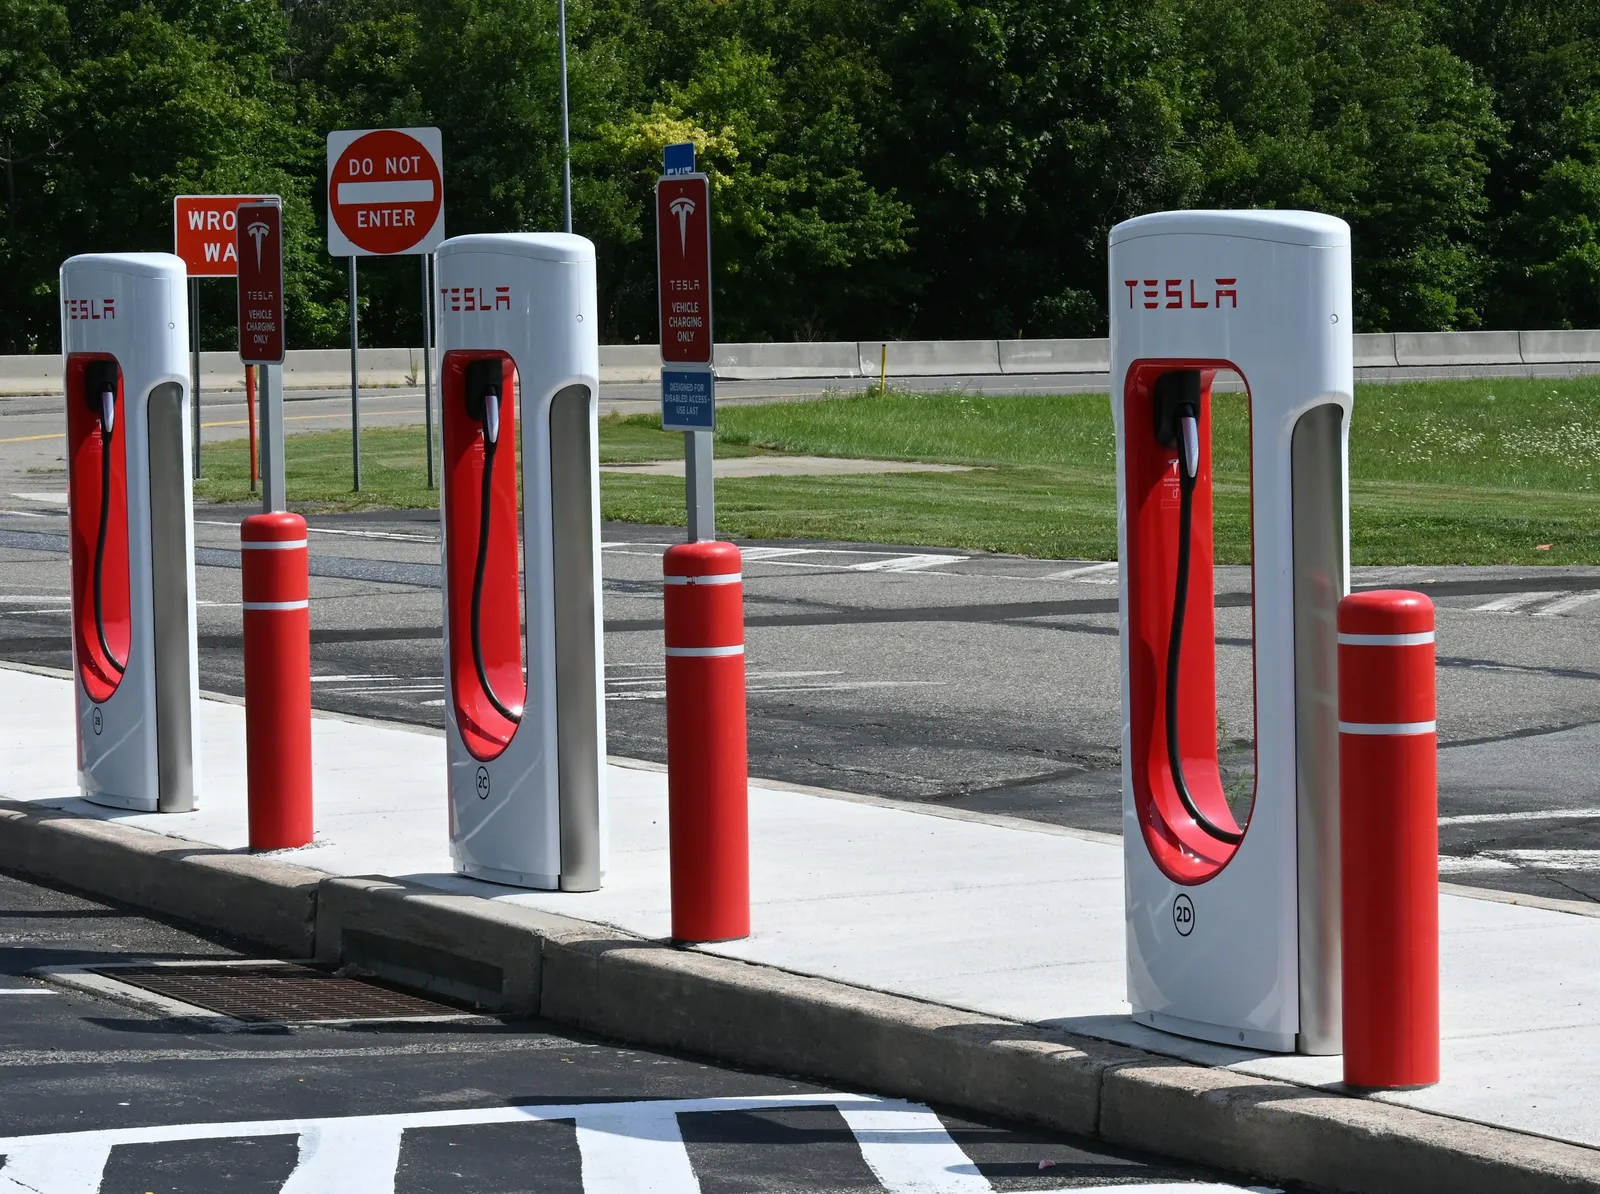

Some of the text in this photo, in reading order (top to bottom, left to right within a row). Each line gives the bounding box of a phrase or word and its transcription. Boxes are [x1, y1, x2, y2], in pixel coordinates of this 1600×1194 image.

[349, 156, 421, 176] DO NOT
[188, 210, 236, 231] WRO
[357, 209, 416, 228] ENTER
[203, 242, 238, 262] WA
[670, 280, 700, 291] TESLA
[247, 291, 274, 300] TESLA
[441, 287, 510, 311] TESLA
[1125, 278, 1237, 309] TESLA
[64, 299, 115, 319] TESLA
[671, 302, 699, 313] VEHICLE
[248, 310, 272, 319] VEHICLE
[246, 322, 275, 331] CHARGING
[668, 316, 703, 328] CHARGING
[253, 334, 268, 344] ONLY
[677, 331, 695, 342] ONLY
[669, 383, 704, 392] DESIGNED FOR
[664, 394, 688, 403] DISABLED
[676, 406, 698, 415] USE LAST
[478, 775, 488, 789] 2C
[1176, 905, 1192, 923] 2D
